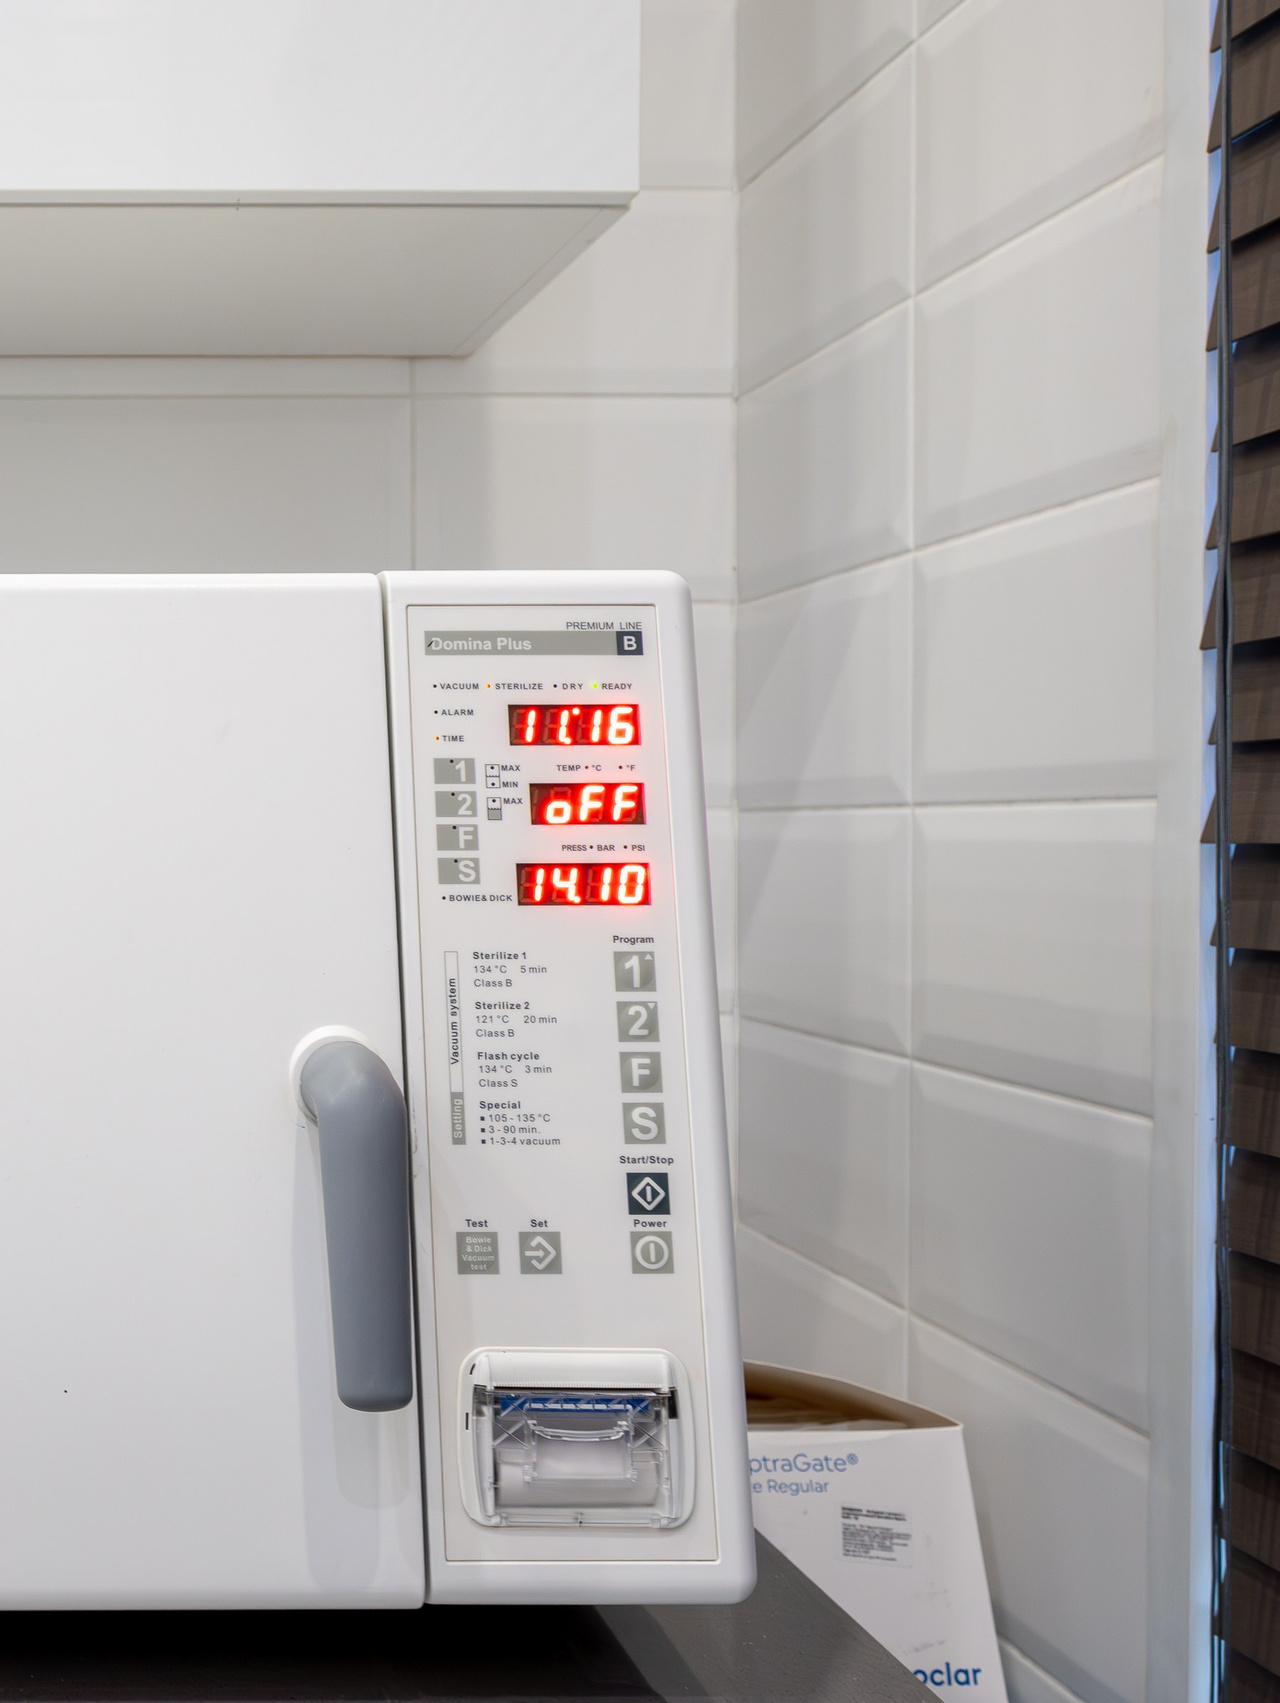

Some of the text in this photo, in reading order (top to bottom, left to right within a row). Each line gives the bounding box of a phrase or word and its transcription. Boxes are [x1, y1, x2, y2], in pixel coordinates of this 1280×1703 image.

[566, 622, 642, 630] PREMIUM LINE
[431, 638, 532, 650] Domina Plus
[623, 636, 637, 650] B
[455, 760, 466, 782] 1
[457, 793, 473, 815] 2
[458, 827, 474, 848] F
[458, 860, 476, 882] S
[613, 936, 655, 945] Program
[473, 952, 527, 960] Sterilize 1
[624, 955, 641, 988] 1
[474, 979, 513, 987] Class B
[475, 1002, 522, 1010] Sterilize
[449, 978, 460, 1065] Vacuum system
[628, 1005, 649, 1036] 2
[476, 1029, 515, 1037] Class B
[477, 1052, 540, 1062] Flash cycle
[479, 1065, 497, 1073] 134
[525, 1065, 531, 1073] 3
[533, 1065, 552, 1073] min
[630, 1058, 651, 1087] F
[479, 1079, 518, 1087] Class S
[479, 1101, 521, 1110] Special
[452, 1098, 463, 1139] Setting
[489, 1114, 508, 1122] 105
[517, 1114, 536, 1122] 135
[631, 1106, 658, 1141] S
[489, 1126, 495, 1134] 3
[503, 1126, 516, 1134] 90
[519, 1126, 541, 1134] min.
[619, 1156, 674, 1165] Start/Stop
[465, 1219, 488, 1228] Test
[530, 1219, 548, 1228] Set
[633, 1219, 667, 1228] Power
[465, 1236, 491, 1244] Bowie
[471, 1263, 487, 1271] test
[767, 1479, 829, 1496] Regular
